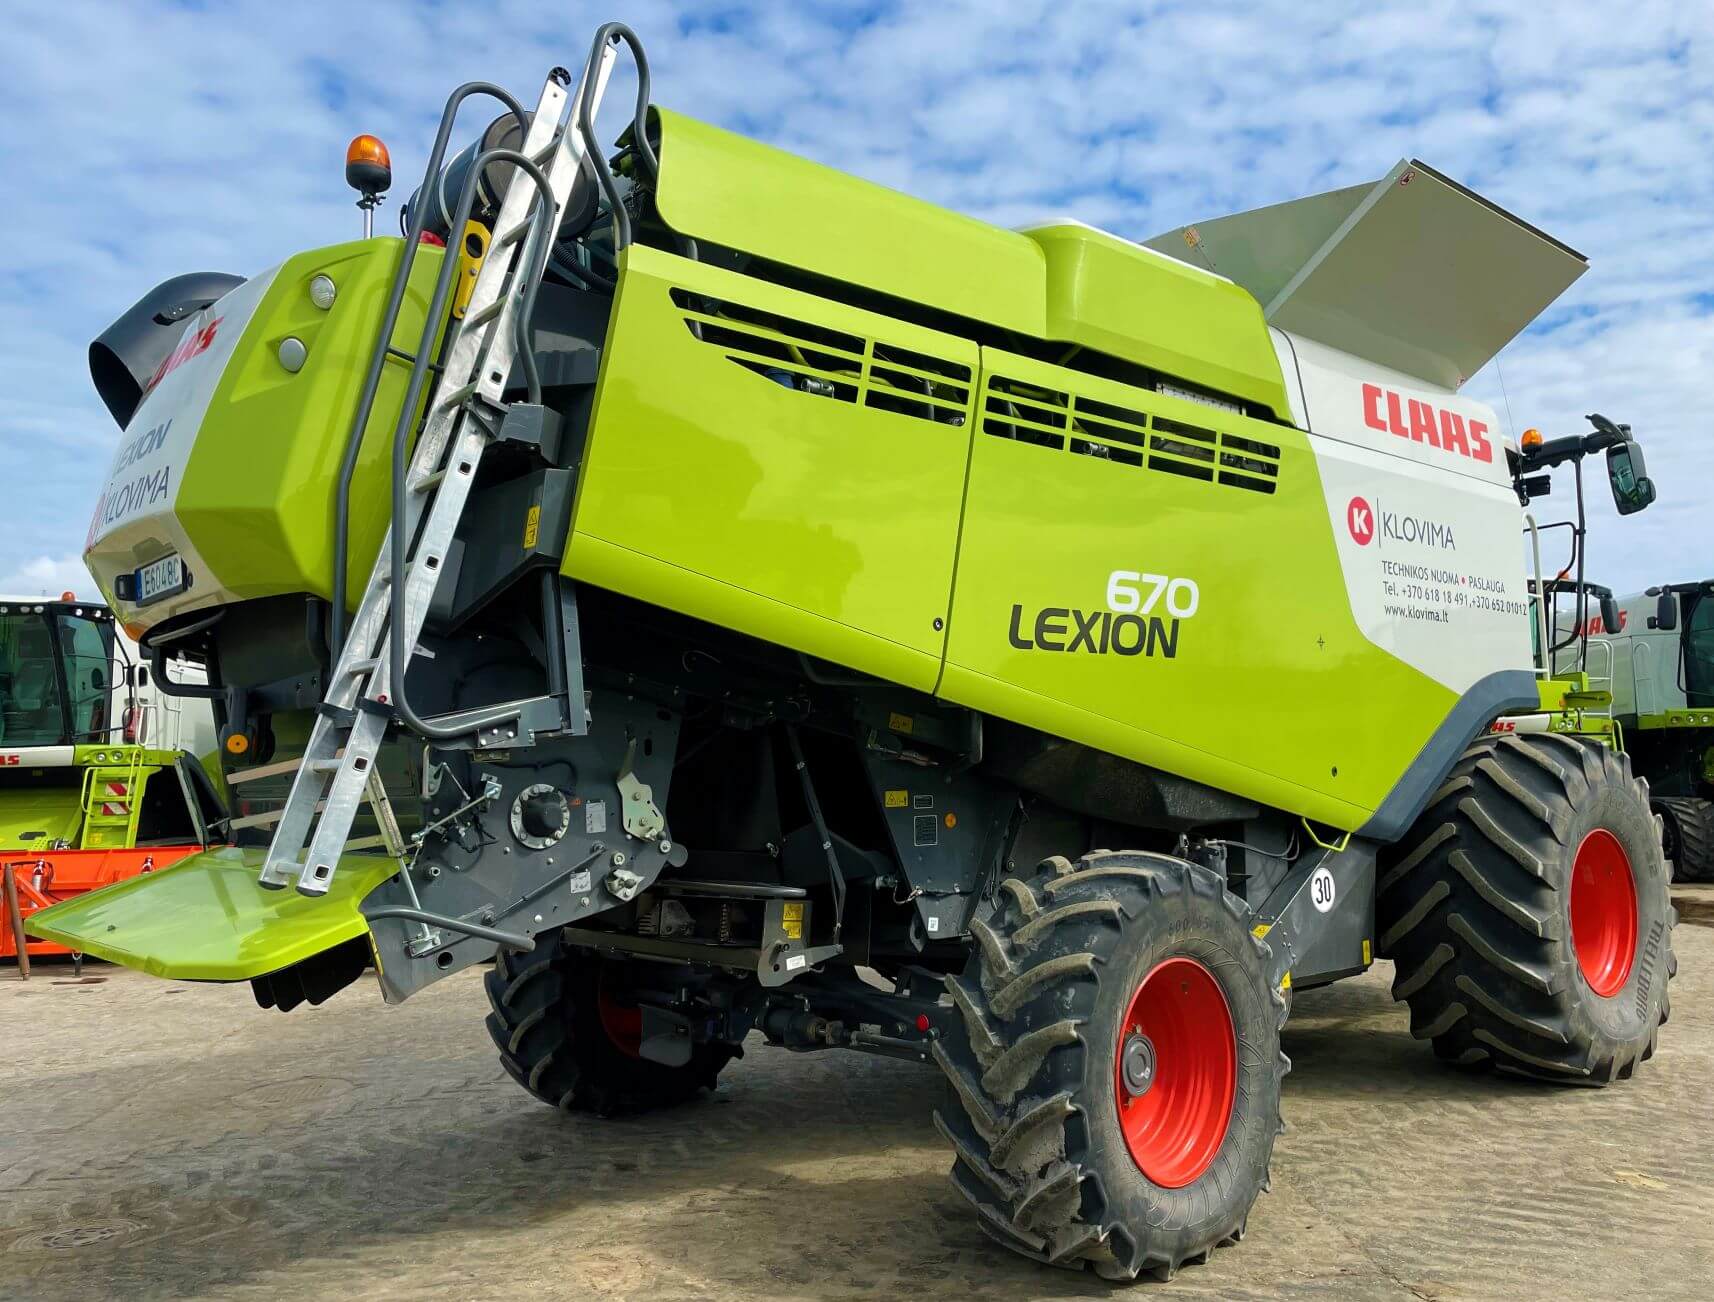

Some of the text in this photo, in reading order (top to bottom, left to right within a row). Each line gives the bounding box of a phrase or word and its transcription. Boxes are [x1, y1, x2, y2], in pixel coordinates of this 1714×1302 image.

[1362, 383, 1493, 464] CLAAS
[1383, 511, 1456, 551] KLOVIMA
[1106, 569, 1200, 619] 670
[1381, 560, 1506, 594] TECHNIKOS NUOMA PASLAUGA
[1382, 581, 1399, 597] Tel.
[1402, 585, 1423, 600] +370
[1425, 588, 1440, 602] 618
[1443, 591, 1452, 604] 18
[1491, 599, 1505, 613] 652
[1506, 601, 1527, 616] 01012
[1384, 604, 1449, 623] www.klovima.lt
[1008, 604, 1180, 659] LEXION
[1315, 876, 1331, 904] 30
